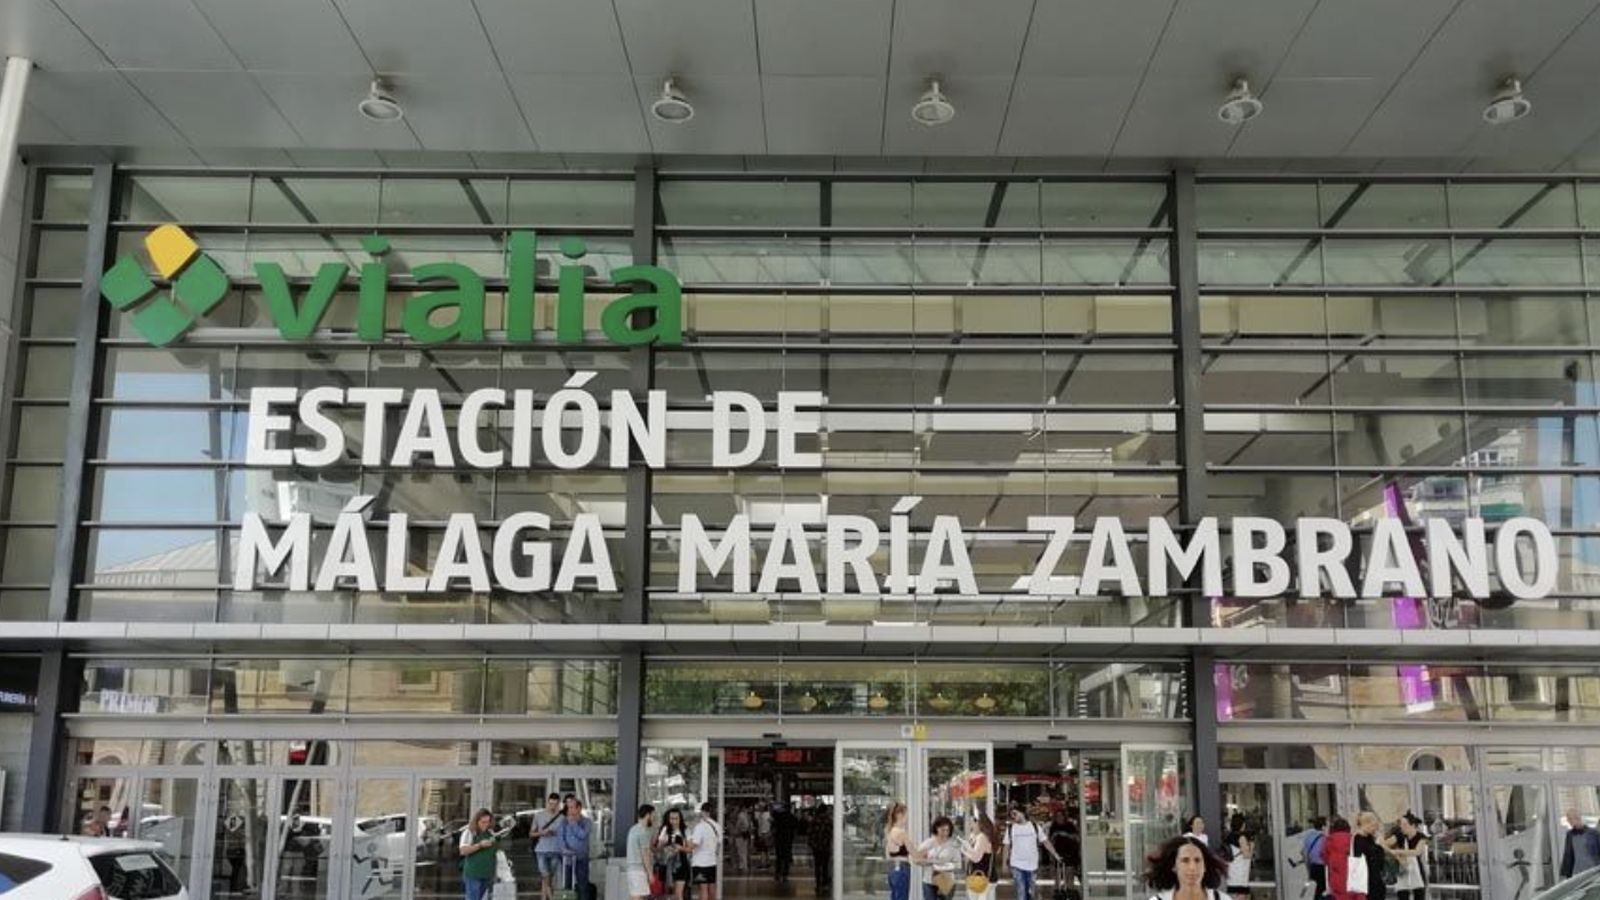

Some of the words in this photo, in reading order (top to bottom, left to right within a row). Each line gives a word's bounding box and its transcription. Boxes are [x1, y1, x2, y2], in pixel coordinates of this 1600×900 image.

[254, 231, 683, 345] vialia
[245, 371, 667, 468] ESTACIÓN
[712, 391, 823, 467] DE
[233, 496, 618, 592] MÁLAGA
[678, 496, 979, 595] MARÍA
[1026, 516, 1558, 599] ZAMBRANO
